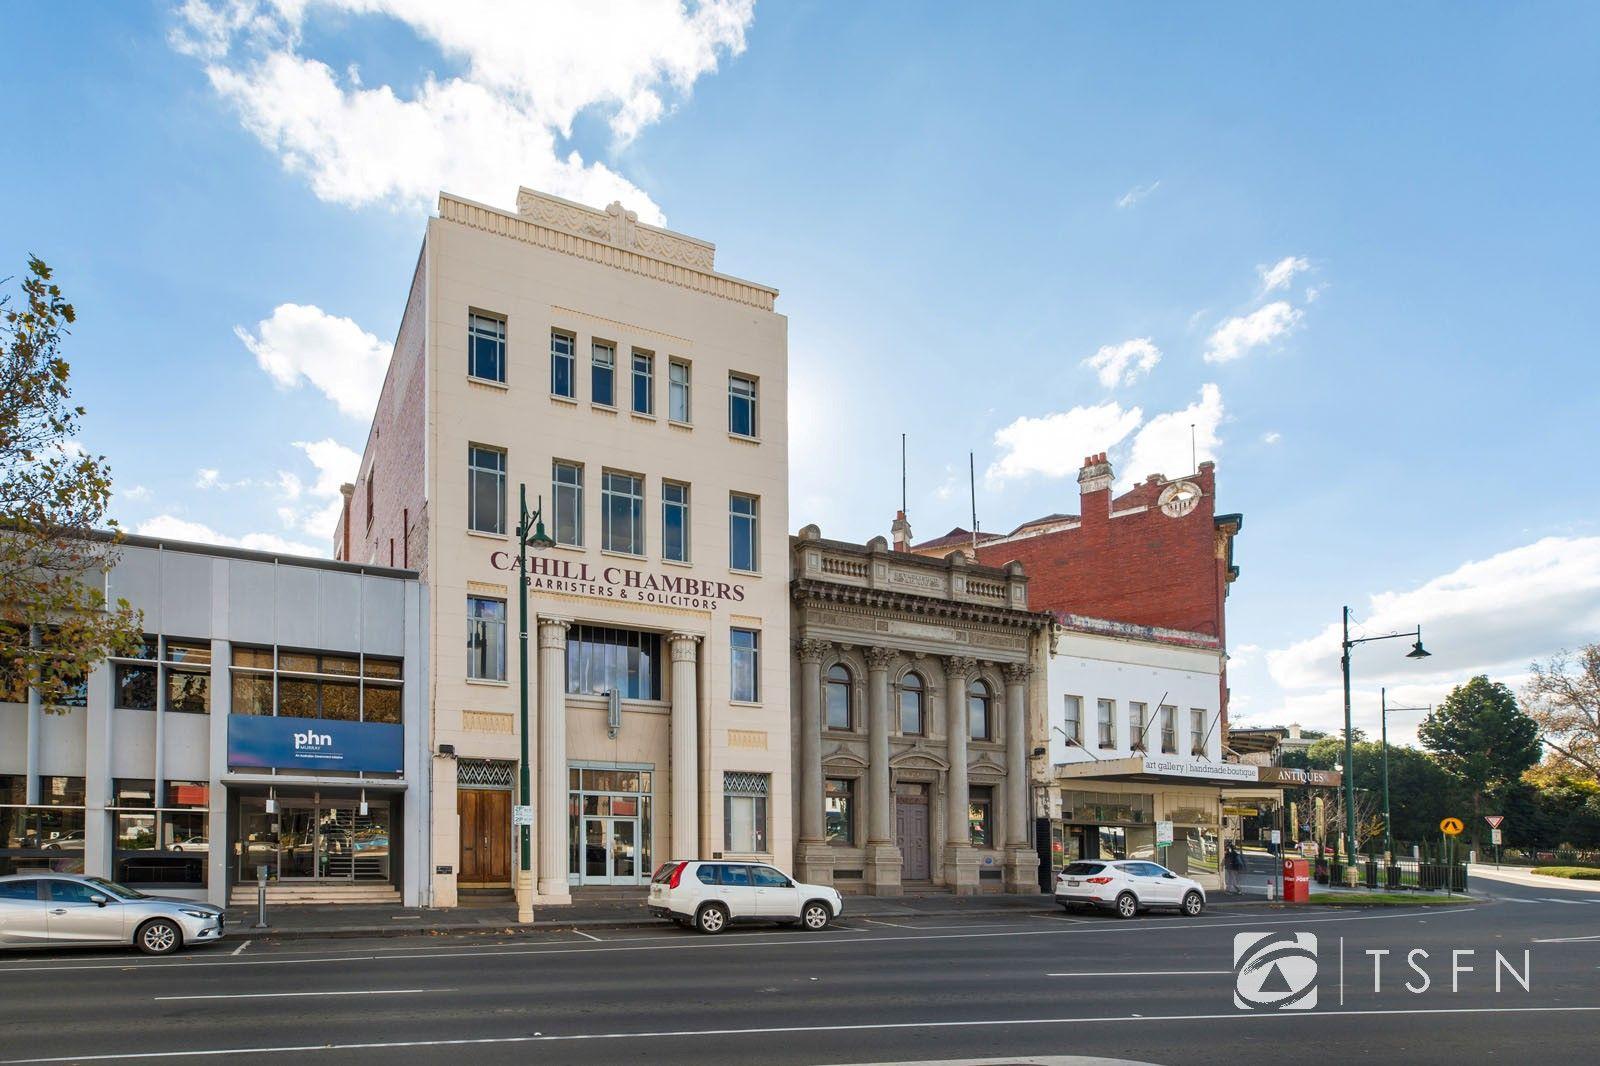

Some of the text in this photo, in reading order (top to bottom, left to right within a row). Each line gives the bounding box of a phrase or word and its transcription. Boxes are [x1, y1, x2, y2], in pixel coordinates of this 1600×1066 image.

[490, 551, 745, 602] CAHILL CHAMBERS
[525, 576, 717, 610] BARRISTERS & SOLICITORS
[294, 729, 332, 749] phn
[1145, 761, 1256, 779] art gallery handmade boutique
[1278, 770, 1324, 784] ANTIQUES
